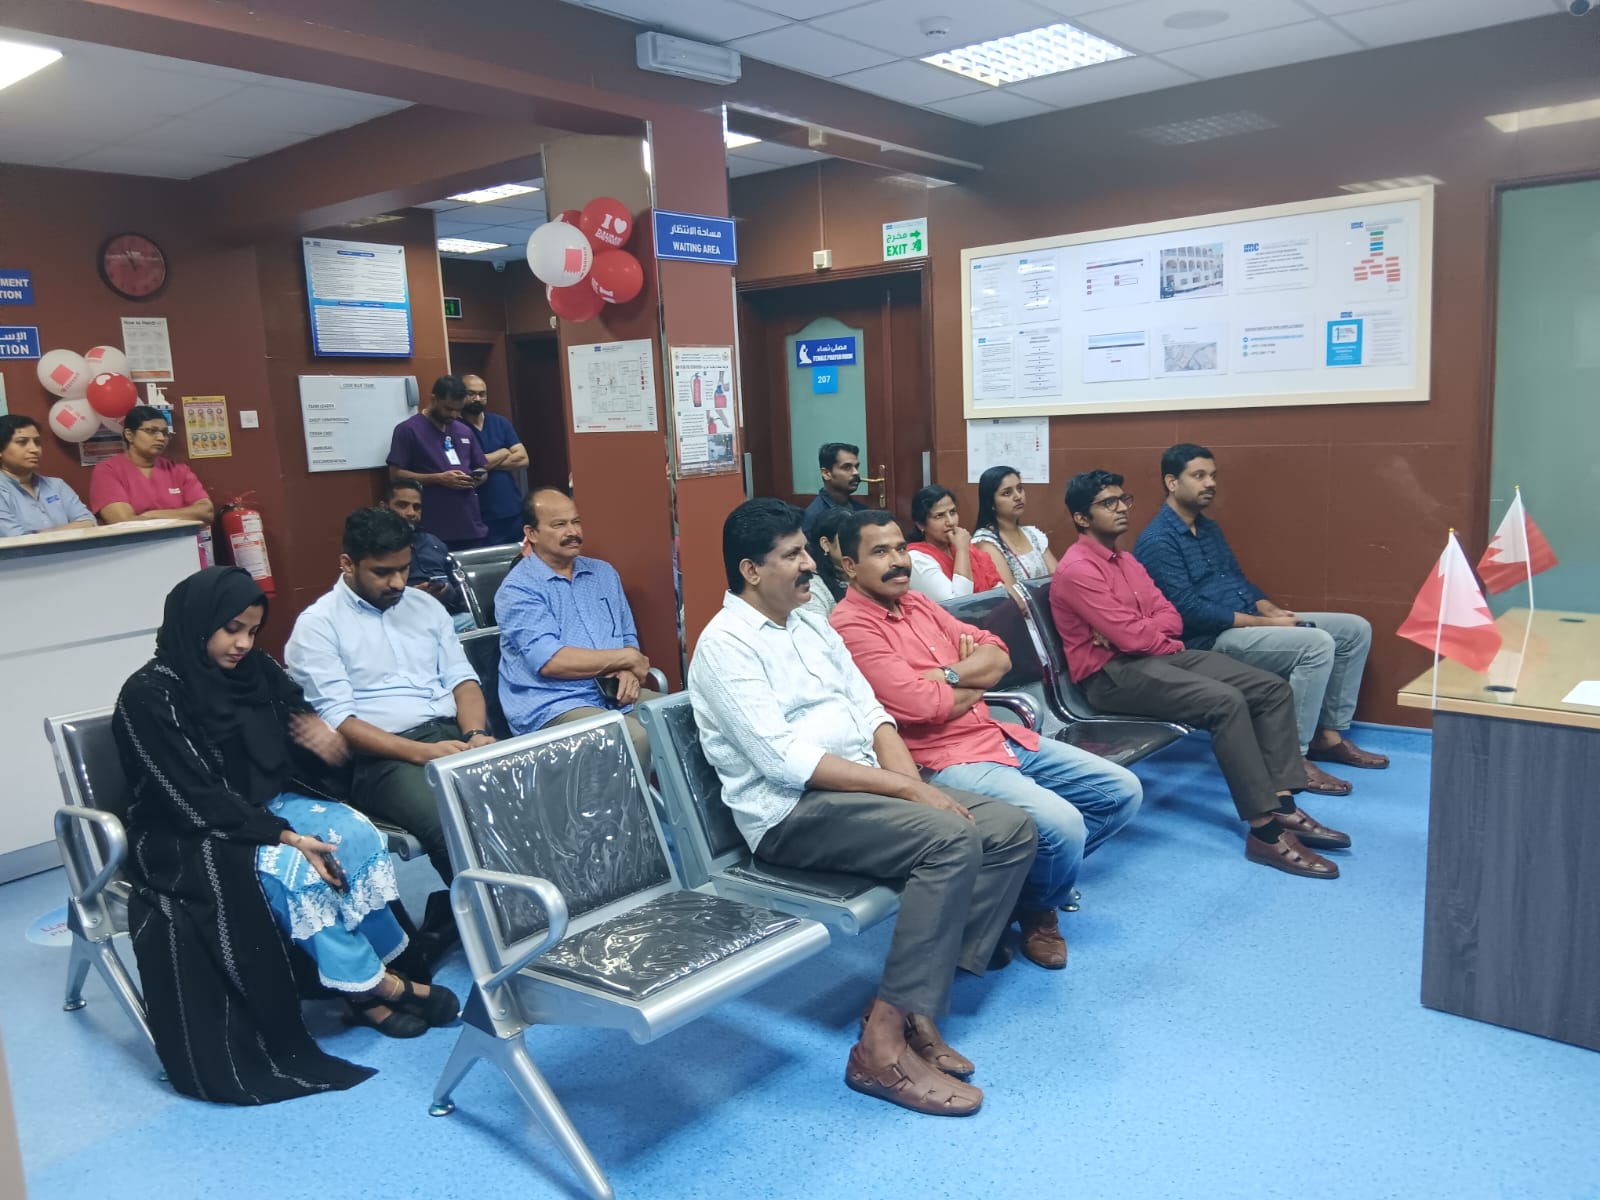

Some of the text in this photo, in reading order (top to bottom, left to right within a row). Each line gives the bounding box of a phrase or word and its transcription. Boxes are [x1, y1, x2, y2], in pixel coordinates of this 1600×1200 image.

[669, 224, 722, 238] مساحة الانتظار
[886, 232, 908, 243] مخرج
[672, 240, 721, 255] WAITING AREA
[886, 243, 908, 257] EXIT
[817, 375, 831, 384] 207
